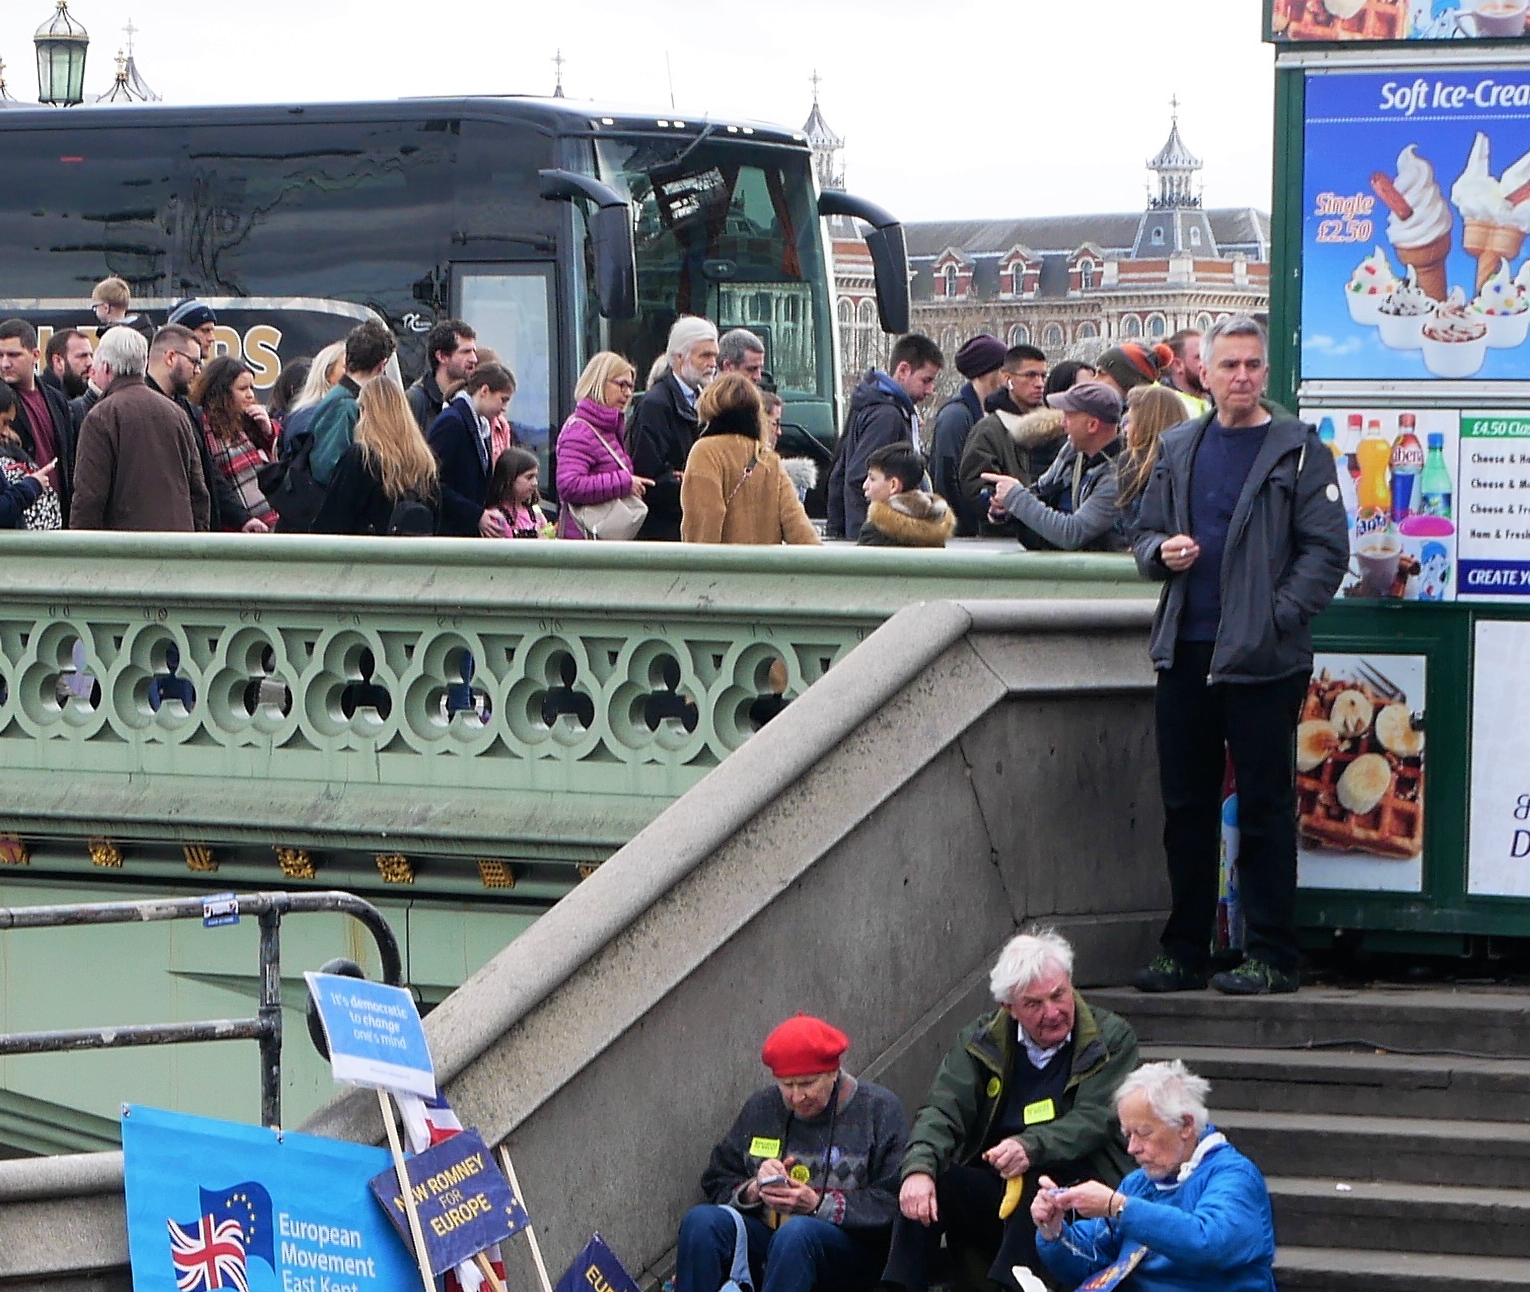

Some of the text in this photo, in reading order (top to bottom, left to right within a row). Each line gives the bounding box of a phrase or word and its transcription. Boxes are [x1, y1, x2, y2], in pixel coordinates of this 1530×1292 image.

[1379, 79, 1429, 116] Soft
[1315, 193, 1374, 220] Single
[1316, 220, 1372, 243] £2.50
[1472, 421, 1506, 436] £4.50
[1472, 454, 1505, 463] Cheese
[1509, 454, 1516, 463] &
[1471, 480, 1505, 489] Cheese
[1509, 480, 1515, 489] &
[1470, 504, 1504, 515] Cheese
[1508, 505, 1515, 515] &
[1470, 530, 1490, 540] Ham
[1495, 530, 1501, 540] &
[1505, 530, 1530, 540] Fresh
[1468, 569, 1517, 586] CREATE
[331, 992, 407, 1019] It's democratic
[349, 1011, 400, 1033] to change
[353, 1028, 407, 1050] one's mind
[427, 1153, 485, 1195] ROMNEY
[439, 1189, 464, 1209] FOR
[430, 1193, 491, 1237] EUROPE
[279, 1213, 361, 1249] European
[281, 1241, 376, 1278] Movement
